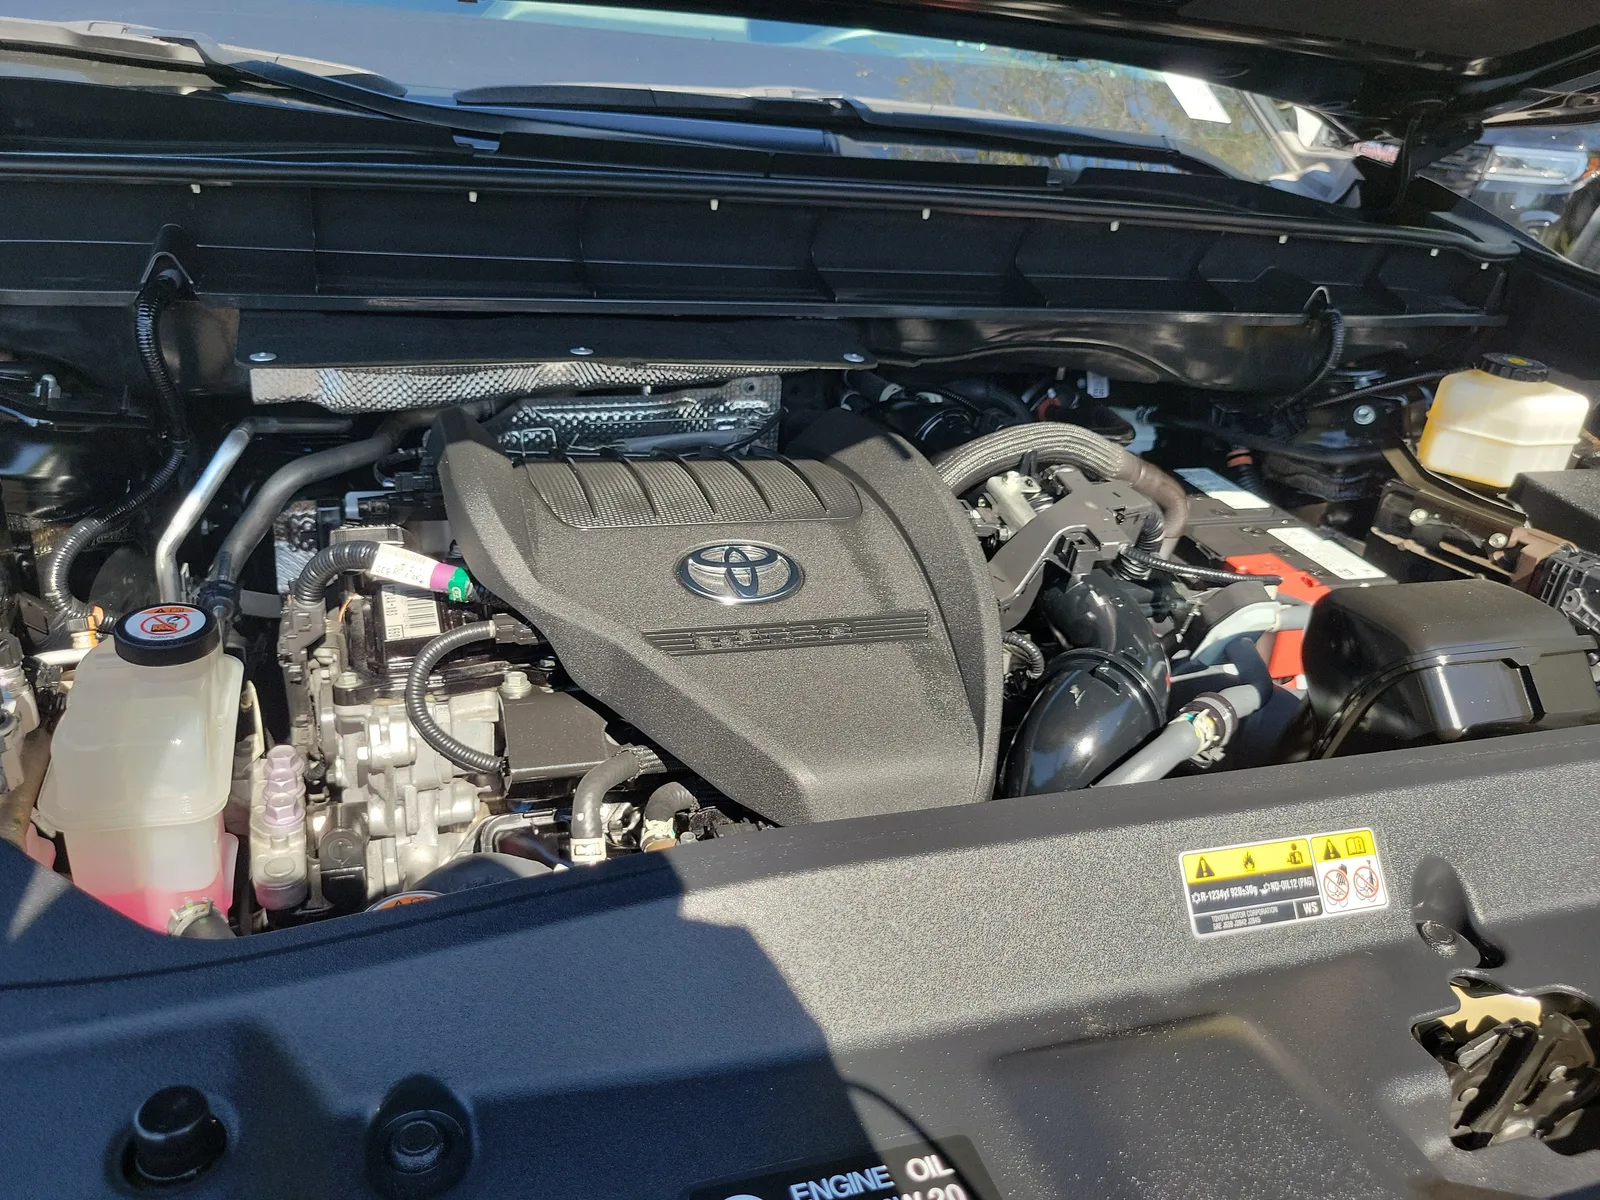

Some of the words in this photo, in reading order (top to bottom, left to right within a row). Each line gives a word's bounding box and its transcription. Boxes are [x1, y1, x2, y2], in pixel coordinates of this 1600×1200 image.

[1200, 888, 1229, 902] R-1234yf
[1298, 877, 1315, 889] (PAG)
[1211, 912, 1229, 922] TOYOTA
[1229, 910, 1246, 920] MOTOR
[1246, 907, 1278, 917] CORPORATION
[1302, 902, 1319, 914] WS
[789, 1164, 896, 1200] ENGINE
[905, 1154, 956, 1182] OIL
